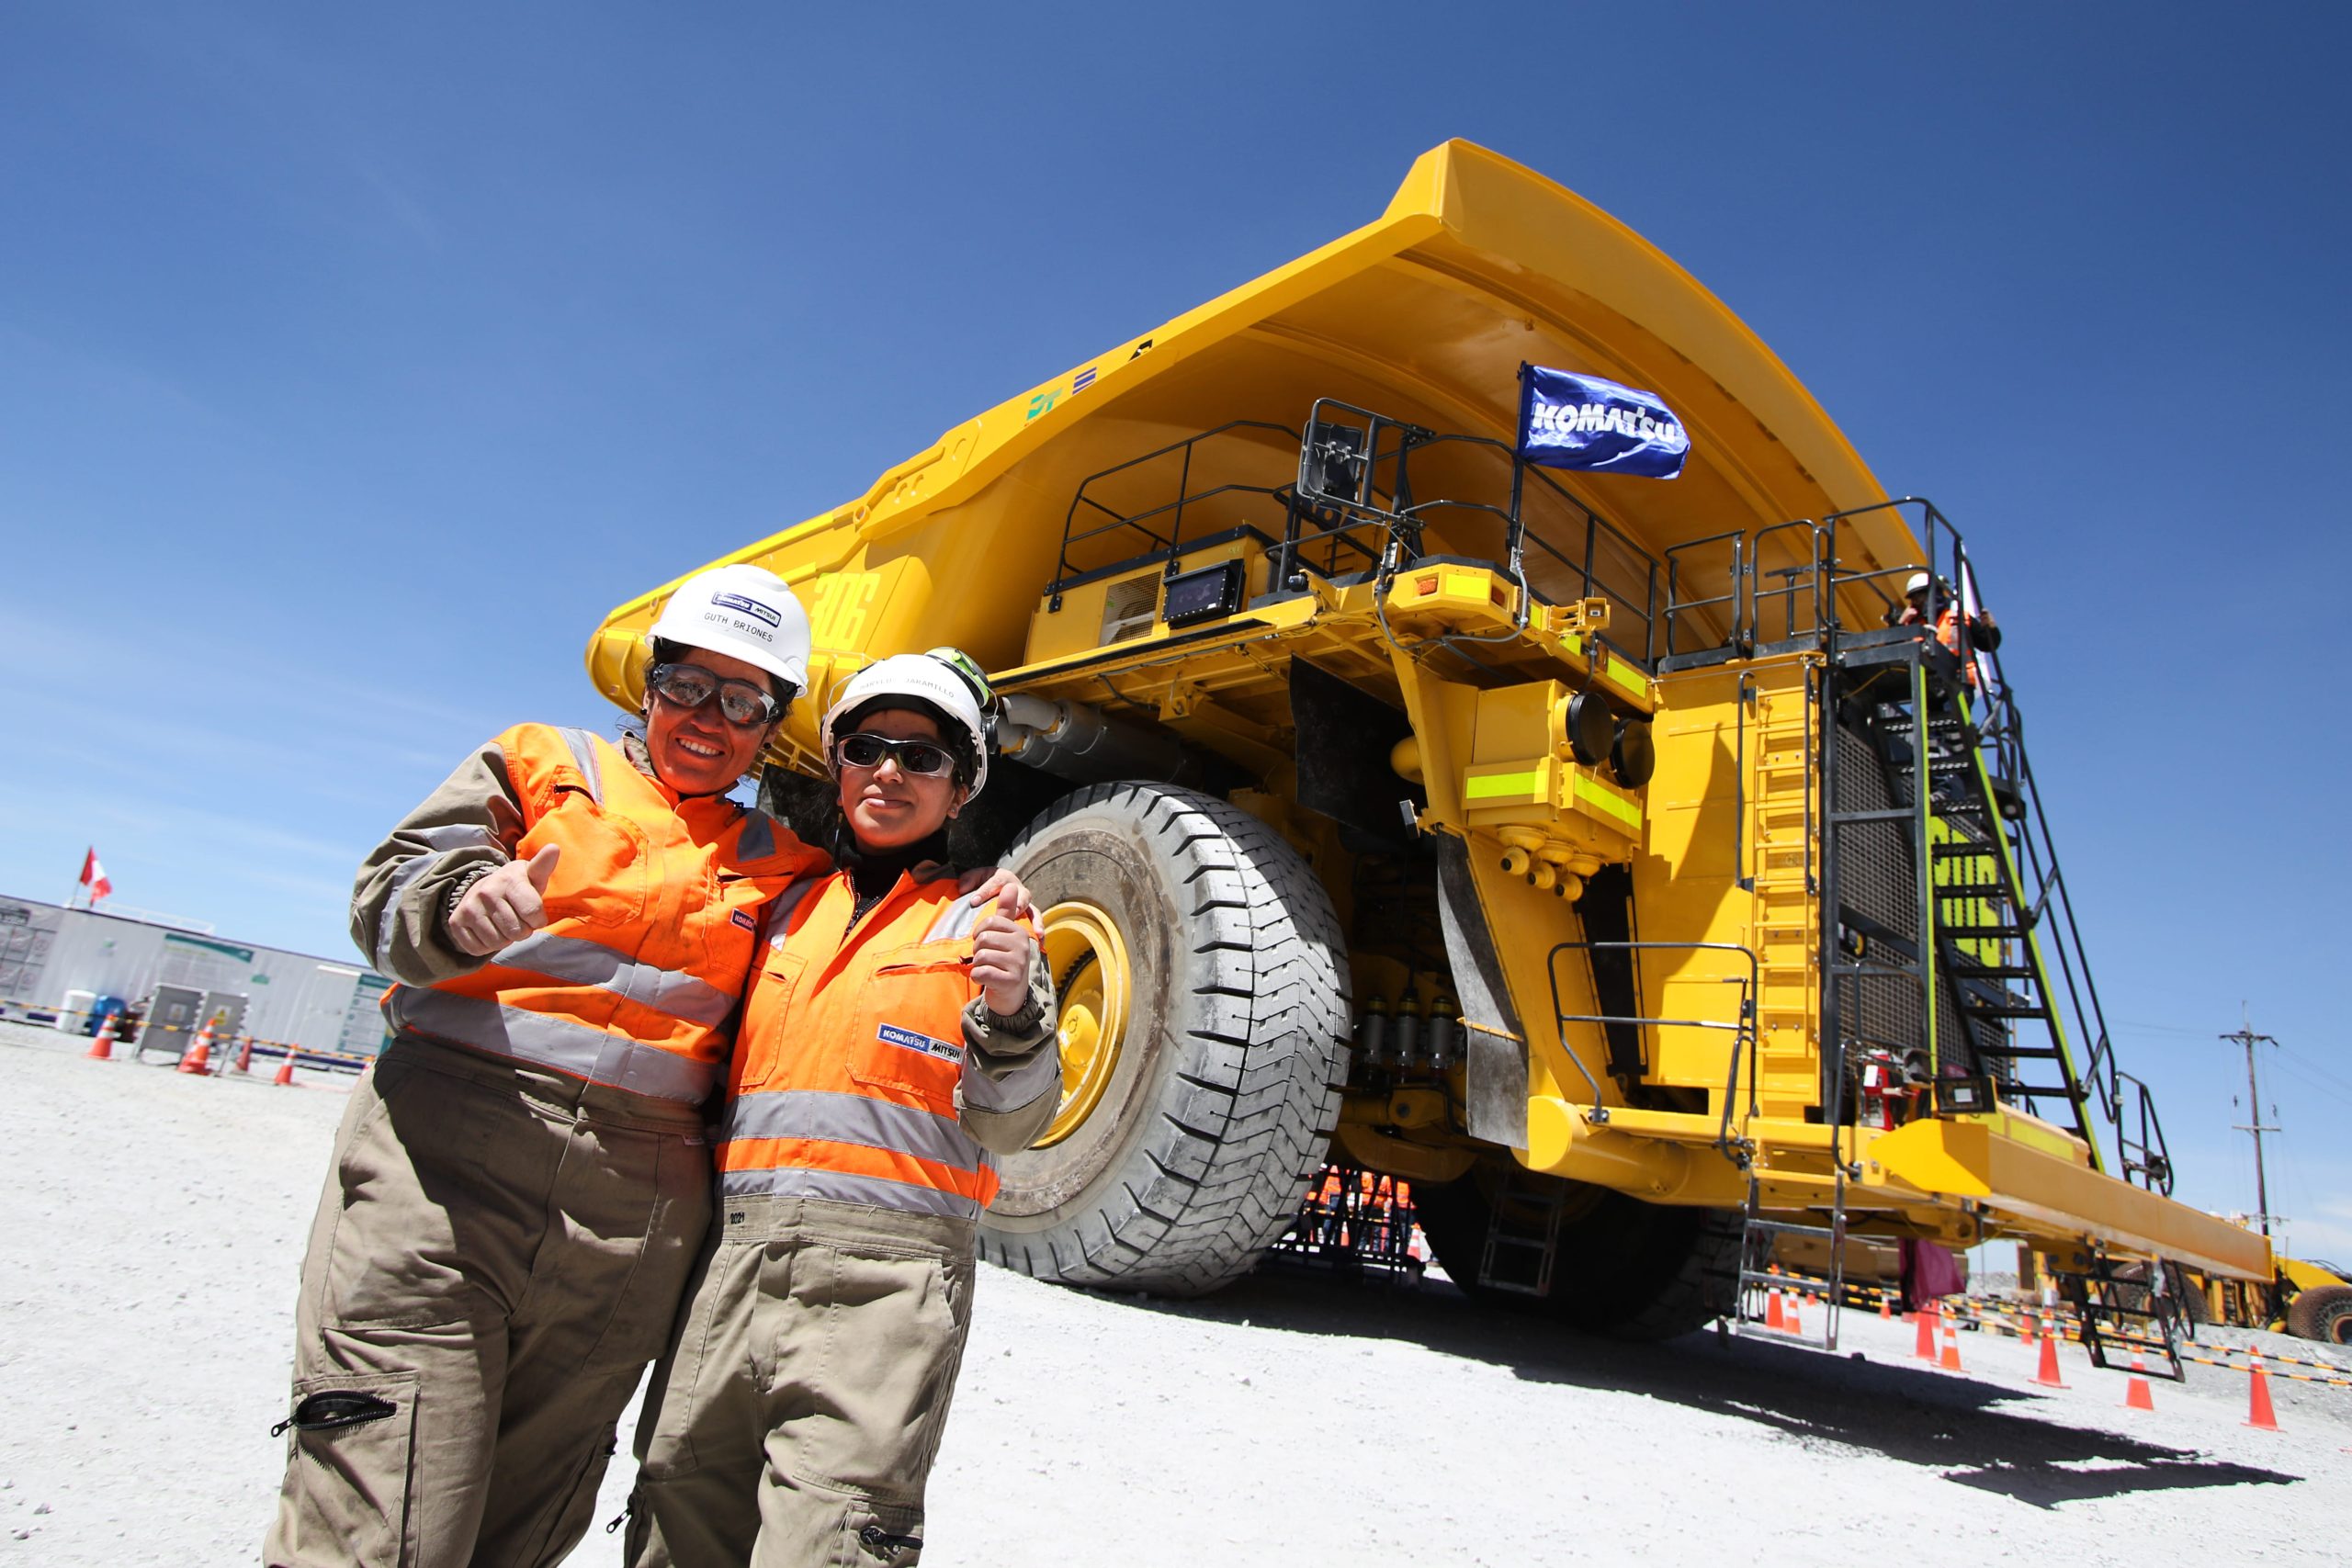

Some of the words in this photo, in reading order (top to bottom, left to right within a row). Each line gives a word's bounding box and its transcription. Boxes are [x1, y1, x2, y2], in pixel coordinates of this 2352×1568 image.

[1532, 401, 1676, 444] KOMATSU
[704, 612, 729, 625] GUTH
[733, 620, 774, 643] BRIONES
[754, 607, 776, 621] MITSUI
[904, 678, 955, 698] JARAMILLO
[882, 1029, 926, 1048] KOMATSU
[931, 1043, 960, 1059] MITSUI
